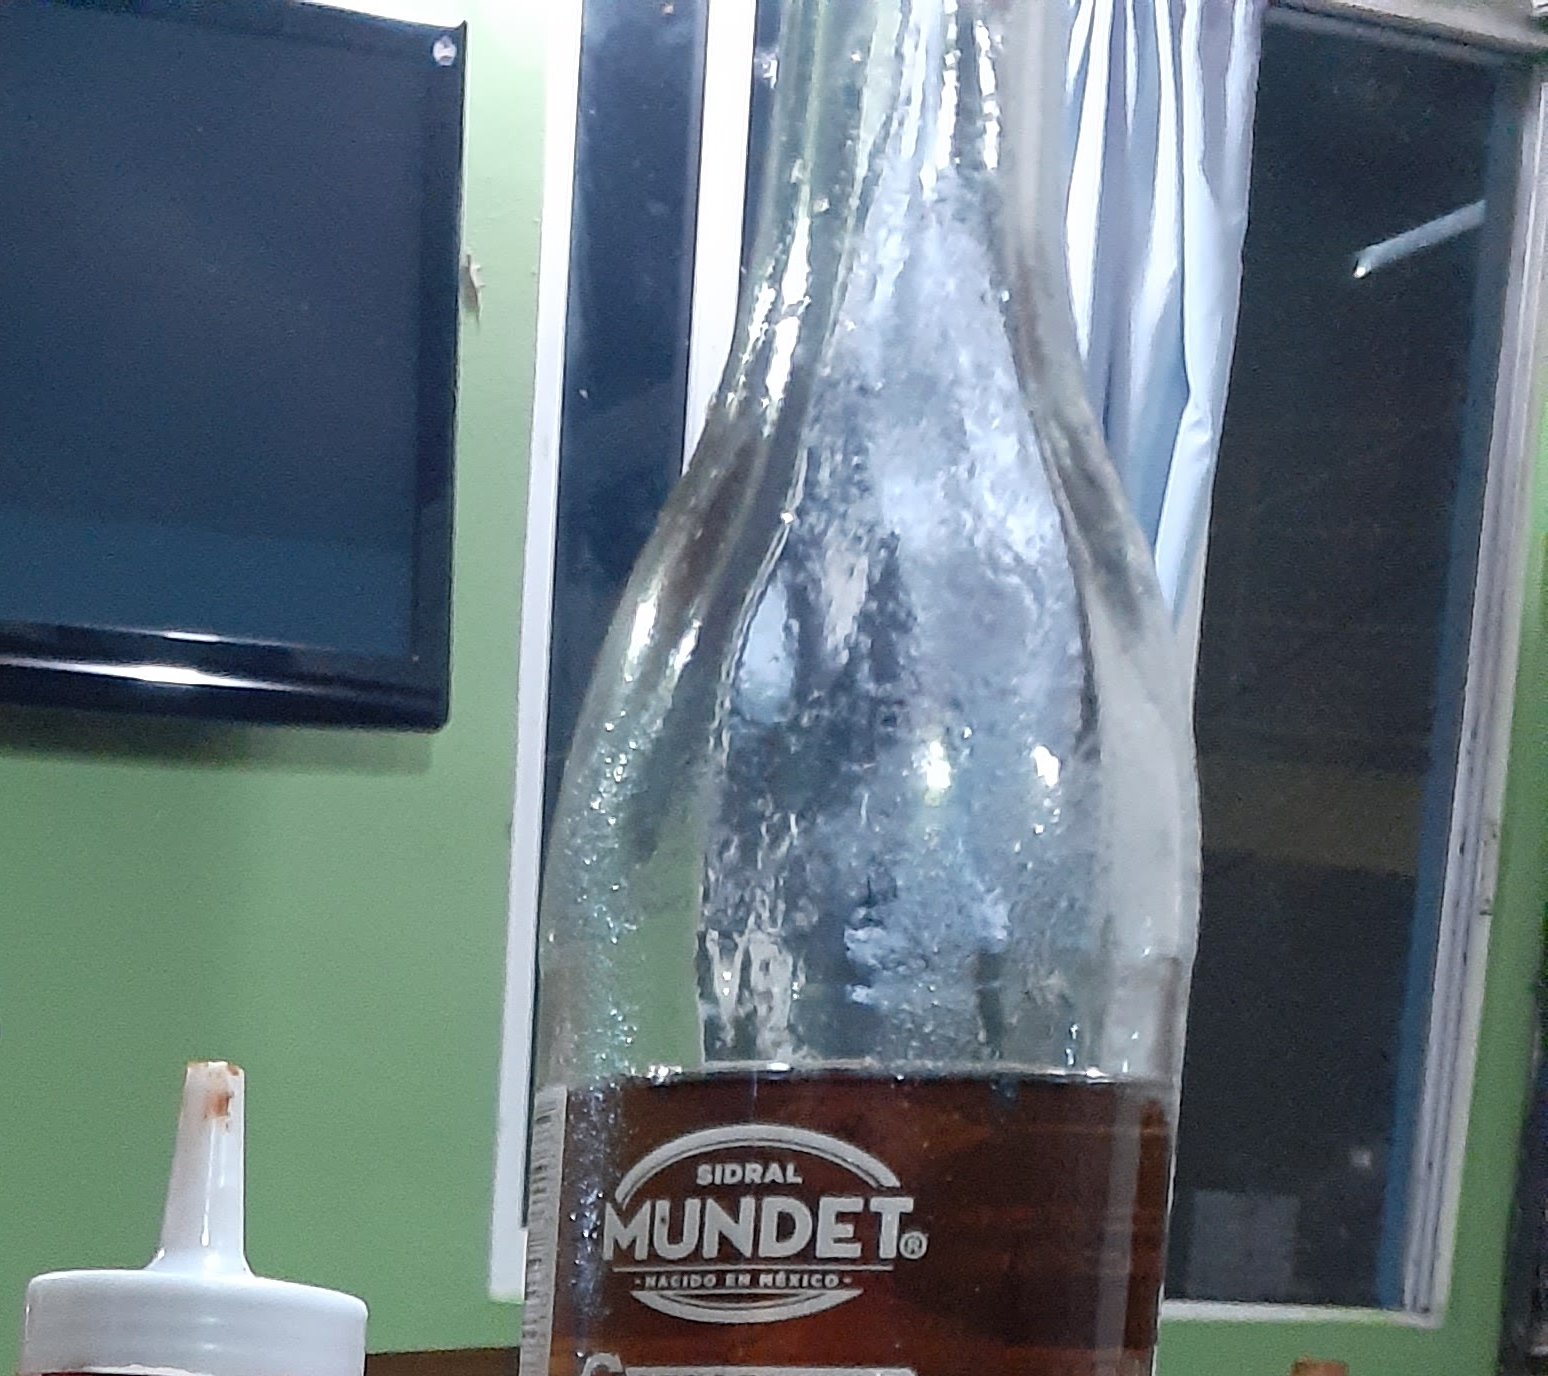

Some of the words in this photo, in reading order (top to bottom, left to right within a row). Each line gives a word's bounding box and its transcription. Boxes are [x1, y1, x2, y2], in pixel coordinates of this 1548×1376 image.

[696, 1163, 802, 1186] SIDRAL
[644, 1274, 716, 1288] NACIDO
[725, 1273, 752, 1287] EN
[758, 1270, 840, 1288] MÉXICO
